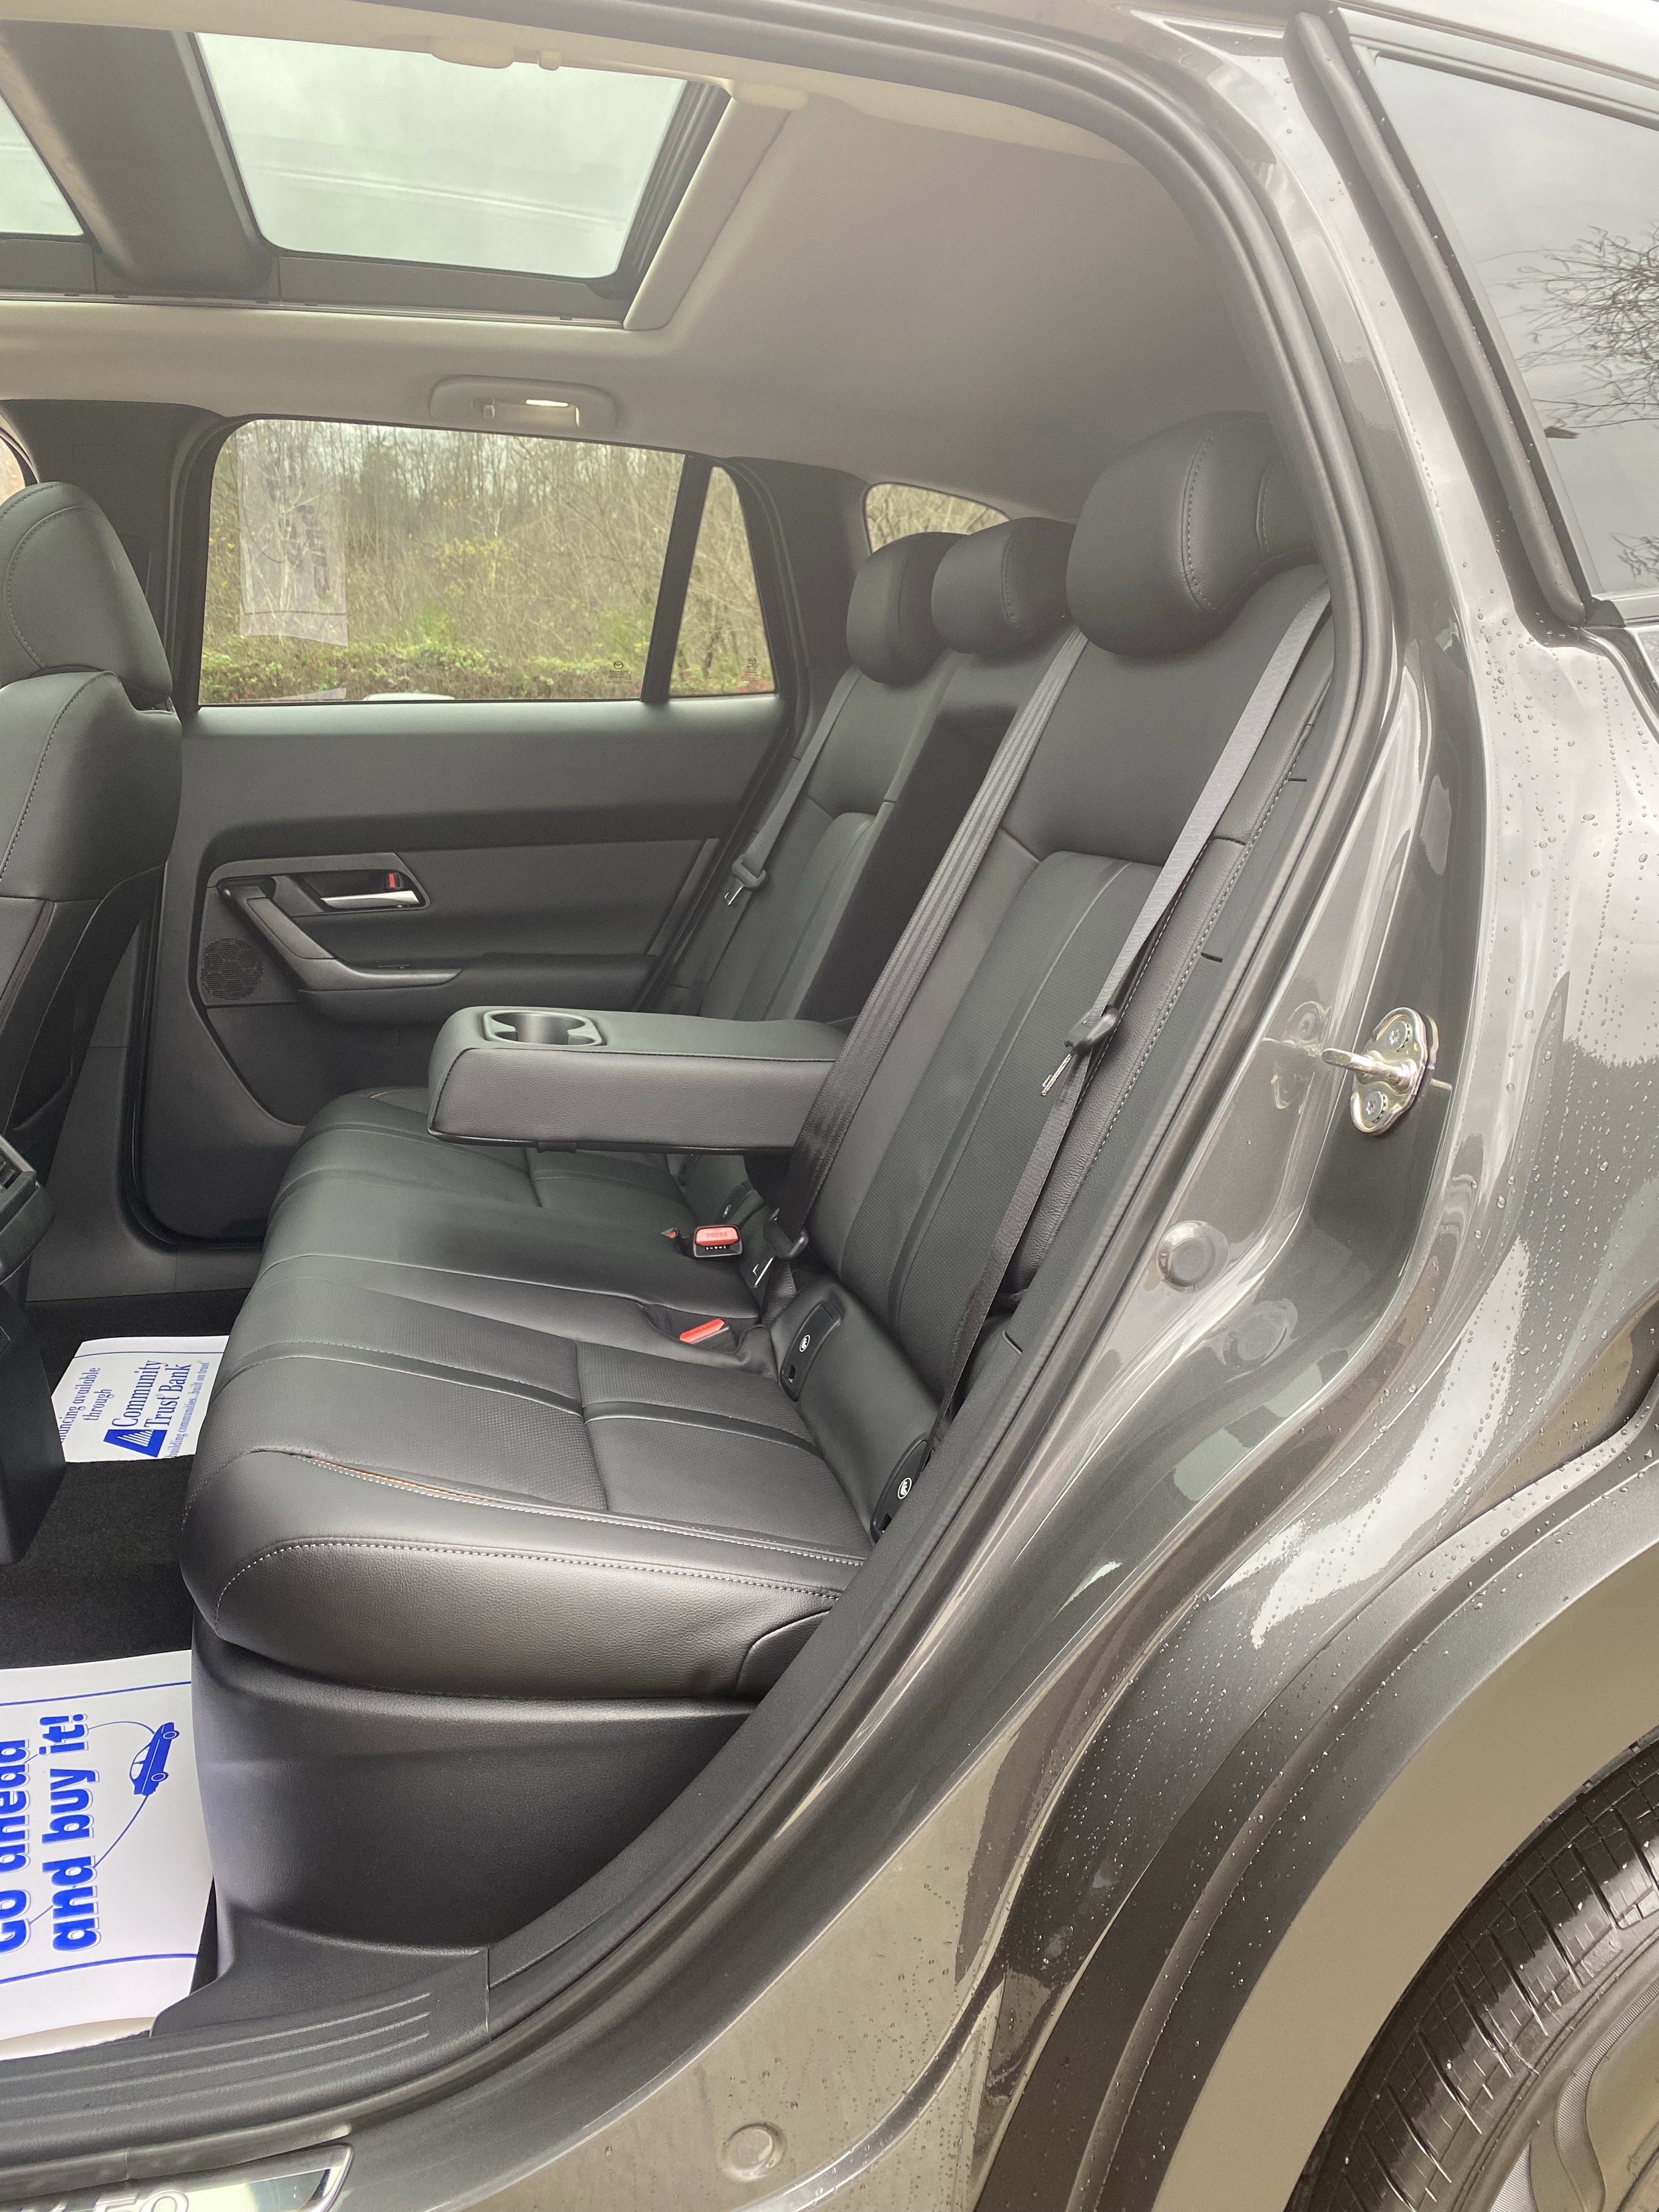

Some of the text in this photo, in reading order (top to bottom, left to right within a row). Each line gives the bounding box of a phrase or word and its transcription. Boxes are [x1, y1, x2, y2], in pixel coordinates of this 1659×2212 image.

[59, 1367, 101, 1443] ancing available
[82, 1389, 115, 1421] through
[111, 1360, 169, 1427] Community
[144, 1364, 192, 1427] Trust Bank
[165, 1433, 188, 1458] building
[196, 1373, 206, 1381] on
[39, 1713, 102, 1952] and buy it!
